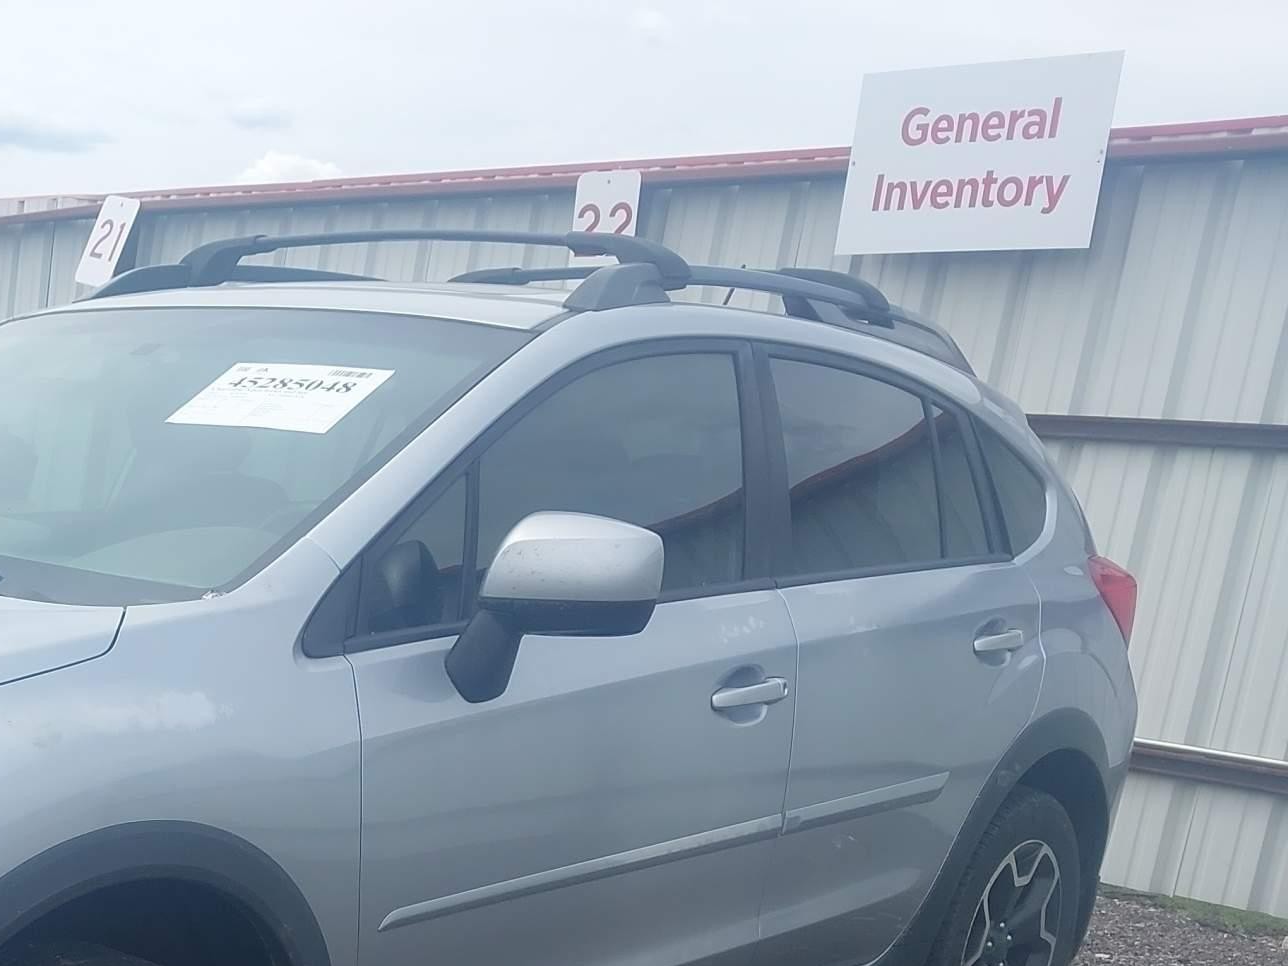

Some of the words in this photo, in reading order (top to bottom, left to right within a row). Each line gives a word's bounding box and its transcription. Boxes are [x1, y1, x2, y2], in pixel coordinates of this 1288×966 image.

[900, 97, 1063, 147] General
[871, 170, 1071, 215] Inventory
[88, 218, 126, 262] 21
[229, 375, 358, 395] 45285048
